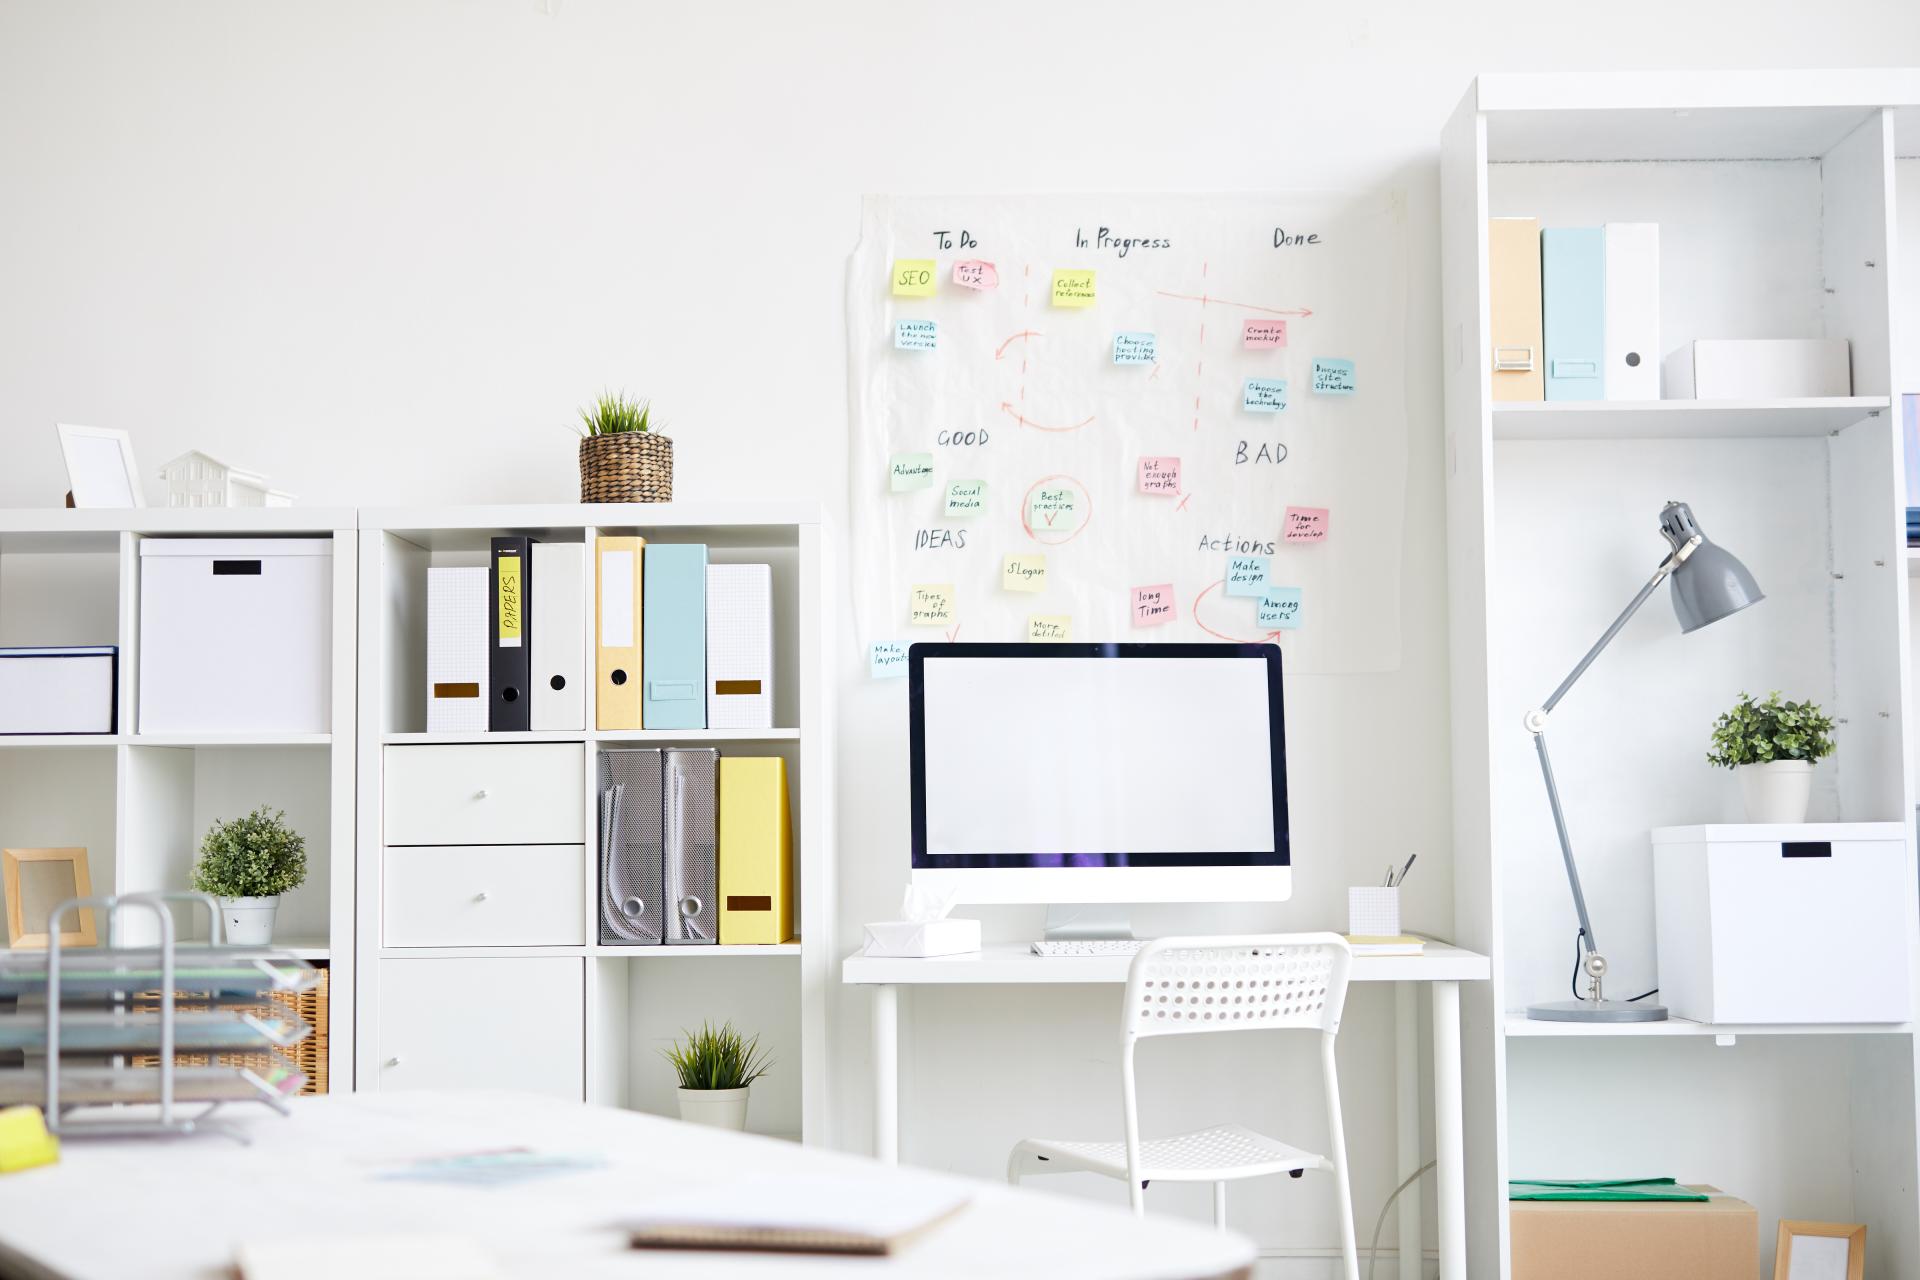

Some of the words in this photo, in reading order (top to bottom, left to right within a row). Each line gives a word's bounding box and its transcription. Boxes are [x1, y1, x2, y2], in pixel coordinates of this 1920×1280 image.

[933, 230, 952, 250] To
[960, 230, 978, 249] Do
[1076, 228, 1088, 248] In
[1097, 227, 1171, 258] Progress
[1273, 227, 1322, 248] Done
[959, 265, 983, 275] Test
[898, 270, 930, 286] SEO
[1057, 278, 1090, 288] Collect
[1247, 326, 1282, 334] Create
[1117, 335, 1153, 346] Choose
[1245, 335, 1280, 343] mockup
[1248, 383, 1283, 392] Choose
[1258, 391, 1272, 399] the
[937, 428, 989, 447] GOOD
[1234, 440, 1288, 465] BAD
[1144, 460, 1159, 470] Not
[1041, 491, 1063, 501] Best
[949, 498, 981, 508] media
[1290, 513, 1320, 522] Time
[915, 529, 969, 551] IDEAS
[1287, 531, 1323, 539] develop
[1198, 532, 1276, 555] Actions
[1232, 560, 1260, 571] Make
[1231, 572, 1263, 586] design
[502, 575, 518, 629] PAPERS
[932, 599, 946, 610] of
[1263, 598, 1299, 613] Among
[913, 608, 949, 621] graphs
[1138, 604, 1170, 618] Time
[1260, 612, 1291, 620] users
[1033, 621, 1060, 629] More
[875, 644, 900, 653] Make
